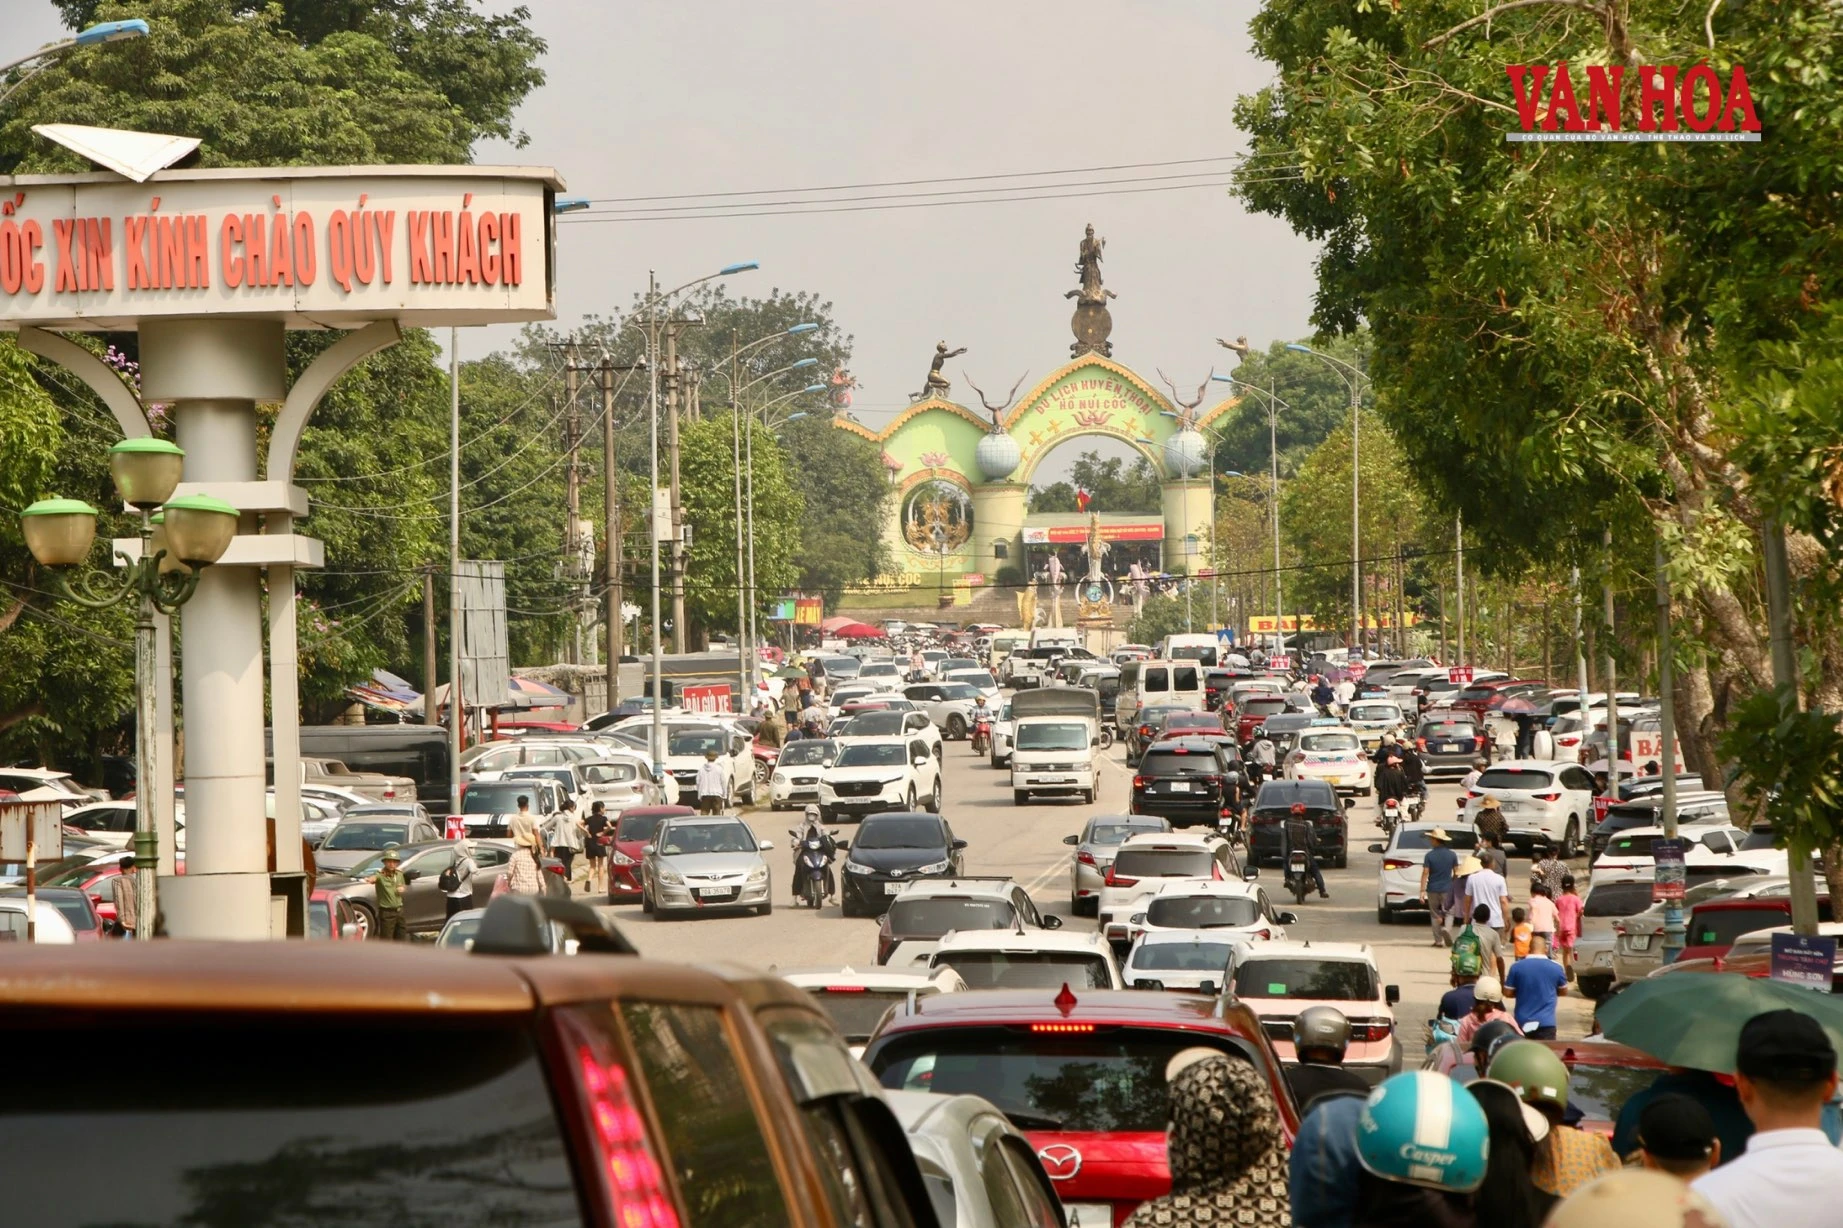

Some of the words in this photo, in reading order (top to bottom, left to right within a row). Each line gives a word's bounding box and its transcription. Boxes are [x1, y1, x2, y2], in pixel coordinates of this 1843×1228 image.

[52, 217, 114, 293] XIN
[124, 196, 210, 290] KÍNH
[221, 195, 317, 288] CHÀO
[328, 193, 396, 293] QÚY
[408, 192, 522, 286] KHÁCH
[1035, 399, 1050, 415] DU
[1081, 376, 1123, 395] HUYỀN
[1123, 387, 1153, 415] THOẠI
[1078, 393, 1100, 410] NÚI
[1103, 393, 1127, 410] CỐC
[685, 693, 700, 712] BÃI
[717, 694, 729, 713] XE
[1399, 1142, 1458, 1167] Casper
